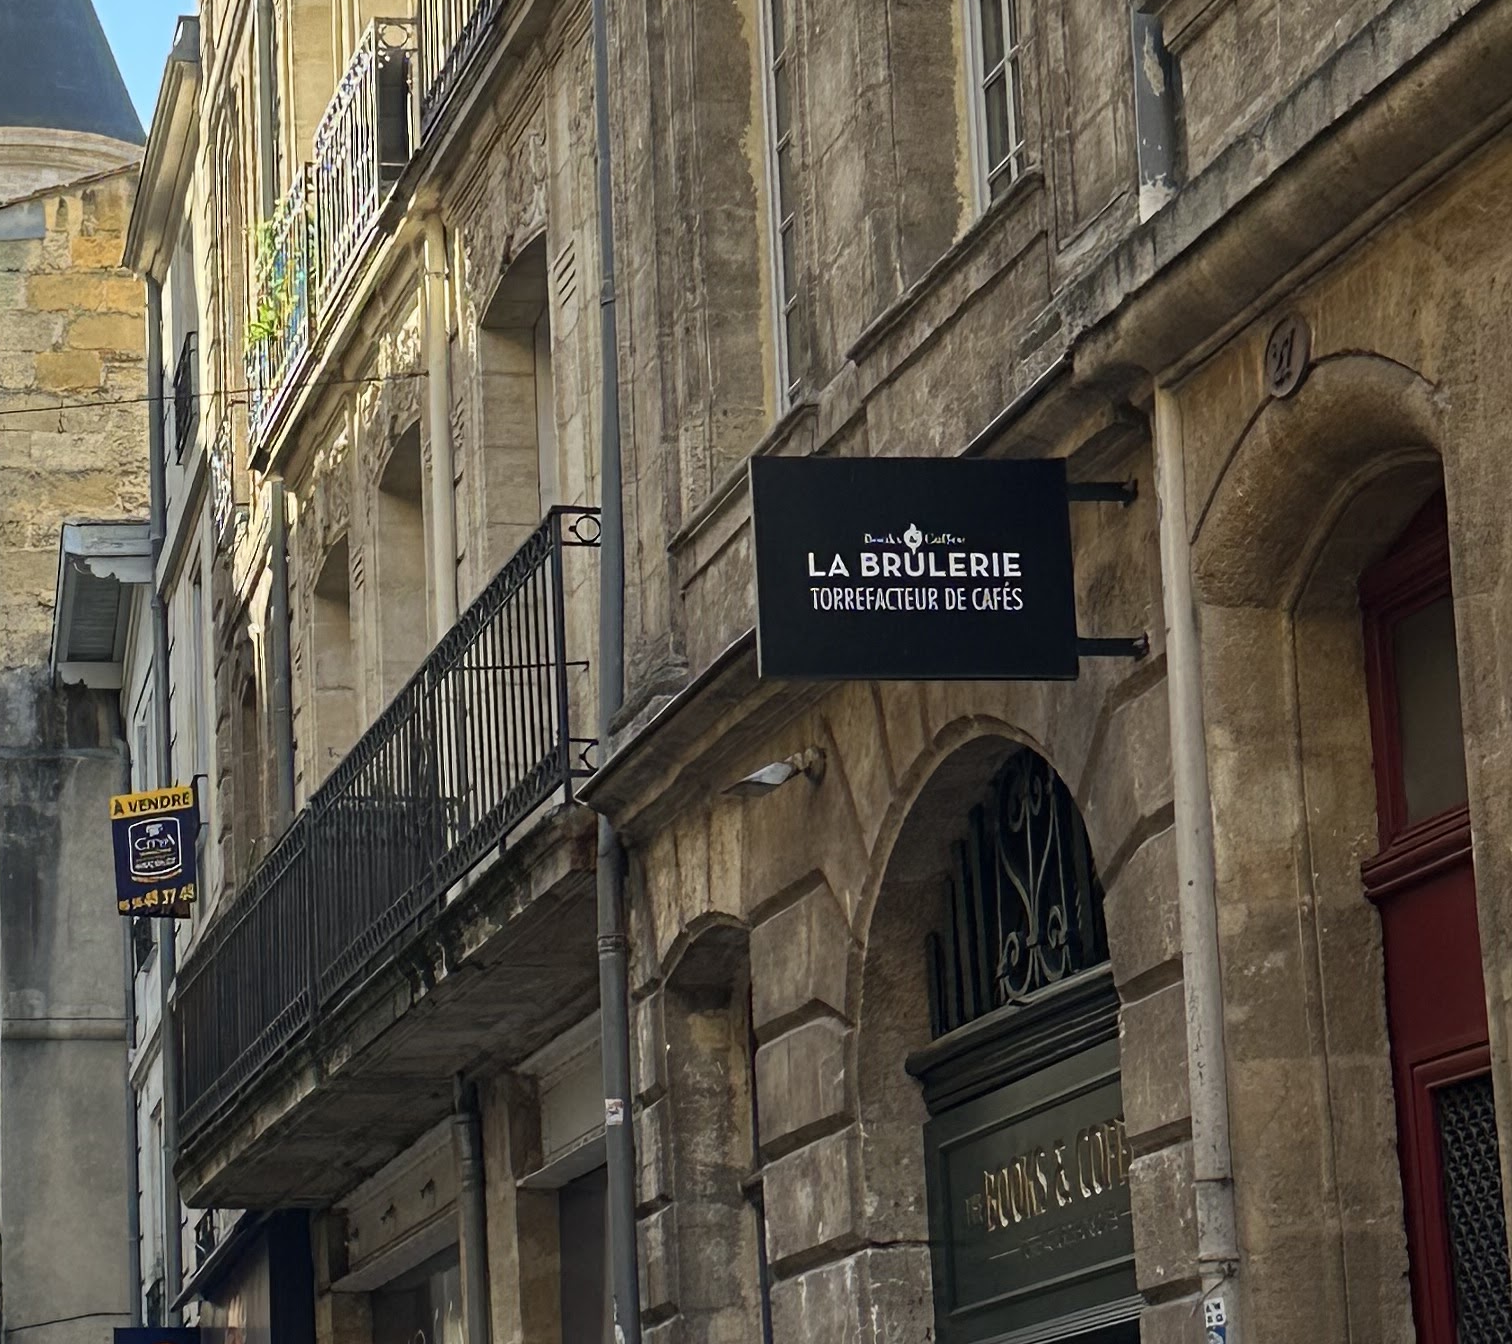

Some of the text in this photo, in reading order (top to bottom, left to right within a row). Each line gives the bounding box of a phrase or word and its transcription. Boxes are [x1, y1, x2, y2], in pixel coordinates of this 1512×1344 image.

[808, 552, 850, 578] LA
[810, 581, 1024, 611] TORREFACTEUR DE CAFÉS
[128, 793, 190, 813] VENDRE
